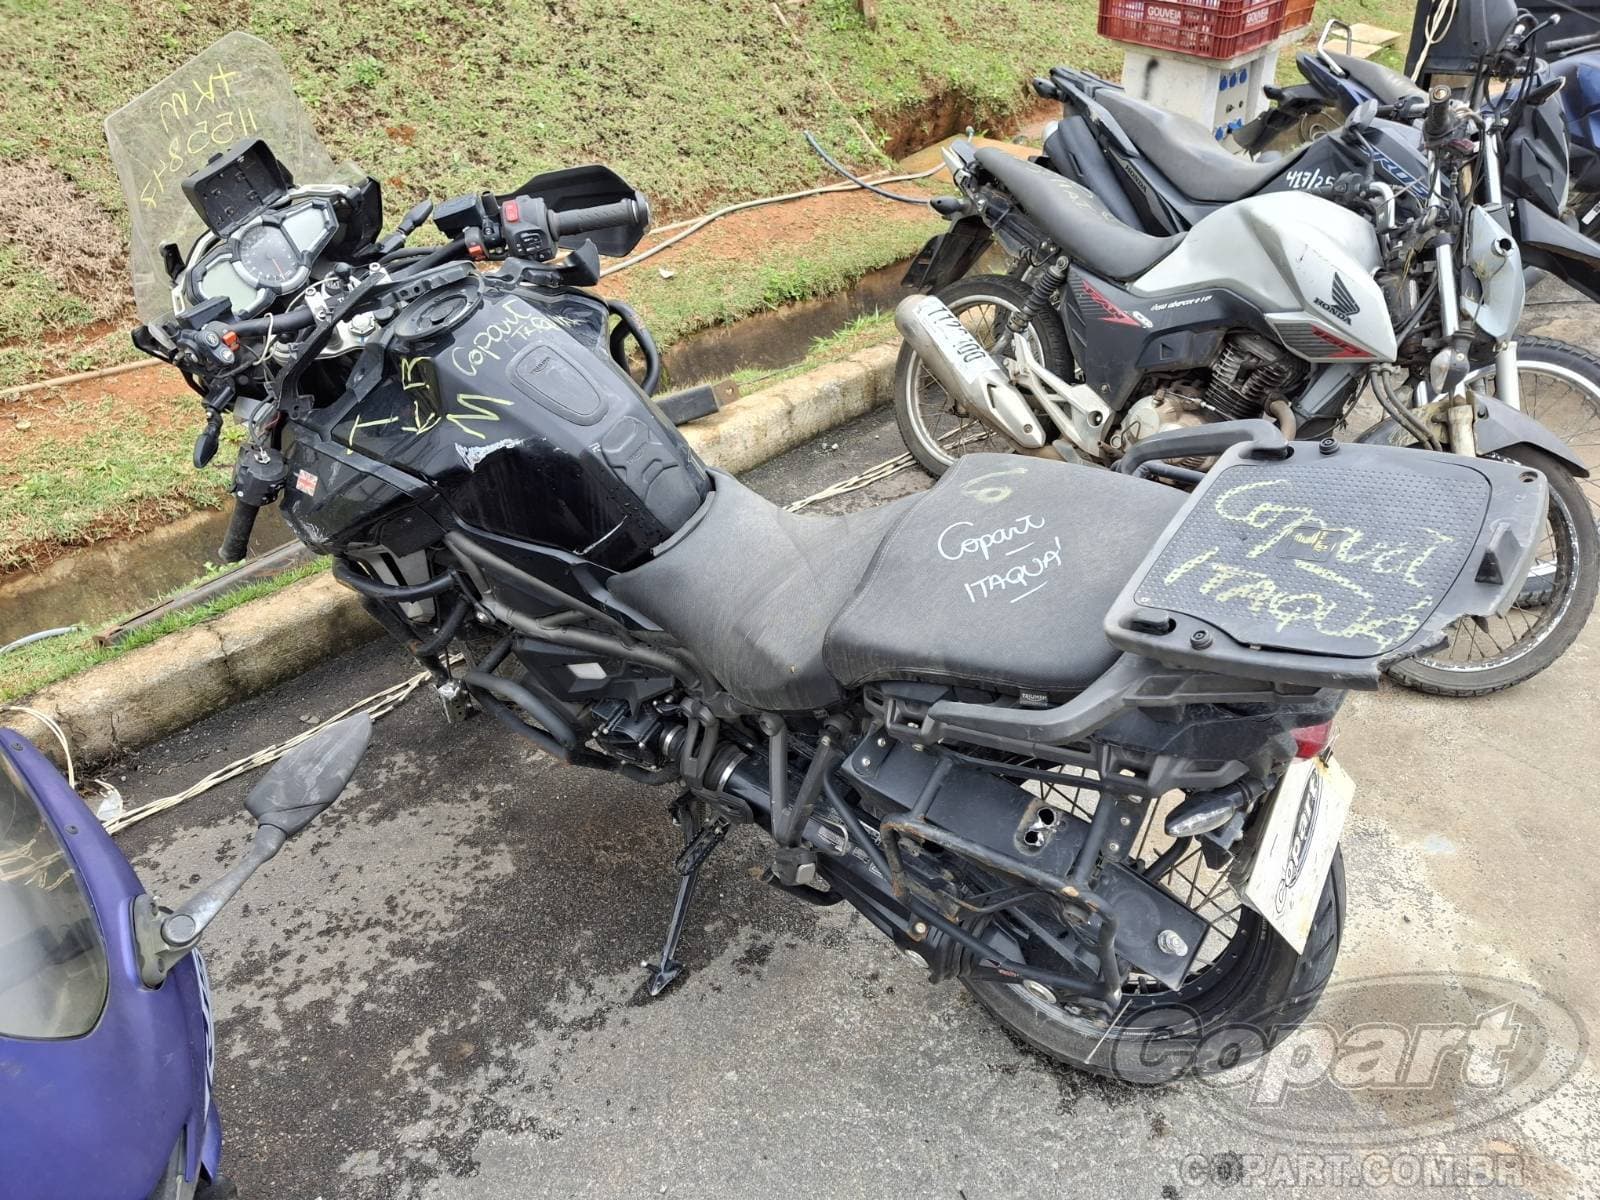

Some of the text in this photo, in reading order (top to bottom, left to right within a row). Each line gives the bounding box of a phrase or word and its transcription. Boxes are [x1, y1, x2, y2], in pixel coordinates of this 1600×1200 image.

[1124, 164, 1149, 194] HONDA
[1313, 297, 1352, 326] HONDA
[937, 514, 1045, 560] Copart
[1275, 766, 1321, 914] Copart
